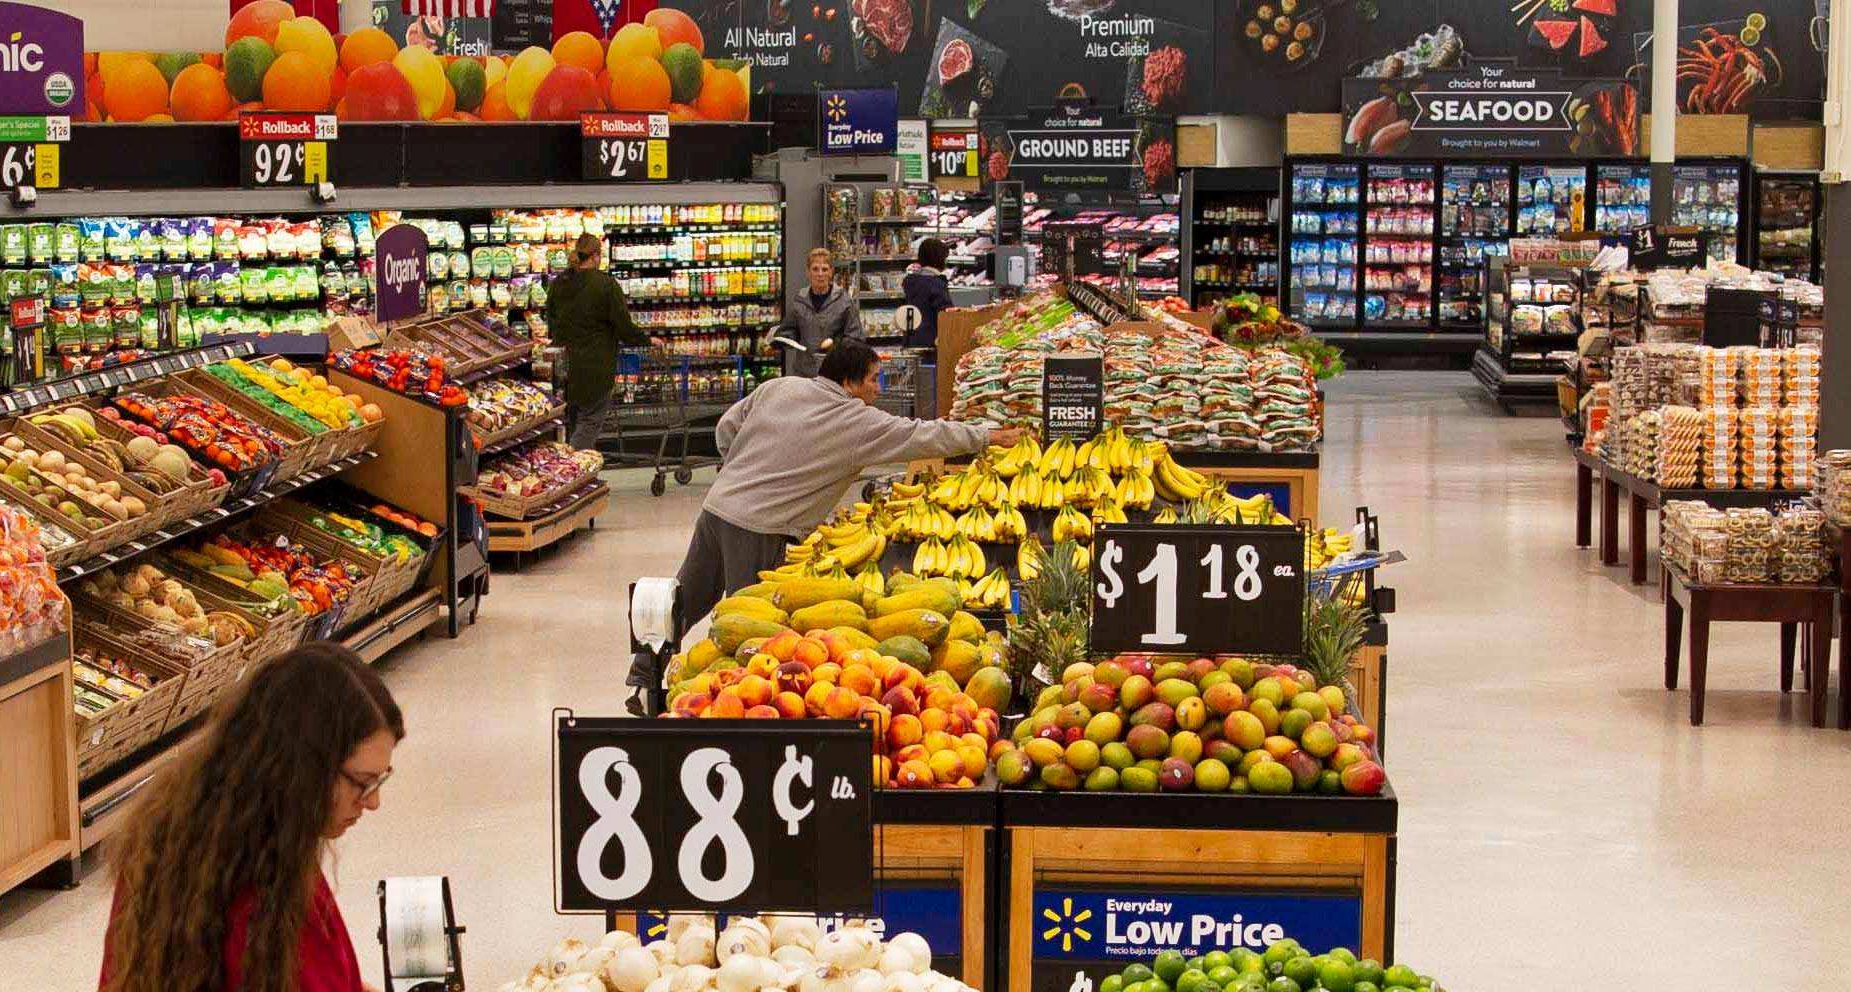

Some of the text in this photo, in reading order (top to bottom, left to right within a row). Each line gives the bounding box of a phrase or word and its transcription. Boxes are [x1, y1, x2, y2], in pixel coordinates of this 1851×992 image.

[1081, 14, 1154, 36] Premium
[724, 27, 796, 48] All Natural
[1085, 42, 1149, 57] Alta Calidad
[756, 52, 789, 66] Natural
[1480, 67, 1503, 77] Your
[1448, 79, 1536, 89] choice for natural
[1429, 101, 1553, 121] SEAFOOD
[262, 120, 310, 134] Rollback
[601, 120, 645, 133] Rollback
[828, 131, 853, 145] Low
[855, 129, 884, 144] Price
[1019, 139, 1131, 158] GROUND BEEF
[385, 247, 420, 294] Organic
[1049, 406, 1096, 420] FRESH
[1273, 565, 1295, 577] ea.
[577, 744, 856, 902] 88¢ lb.
[1106, 899, 1172, 915] Everyday
[1106, 913, 1284, 947] Low Price
